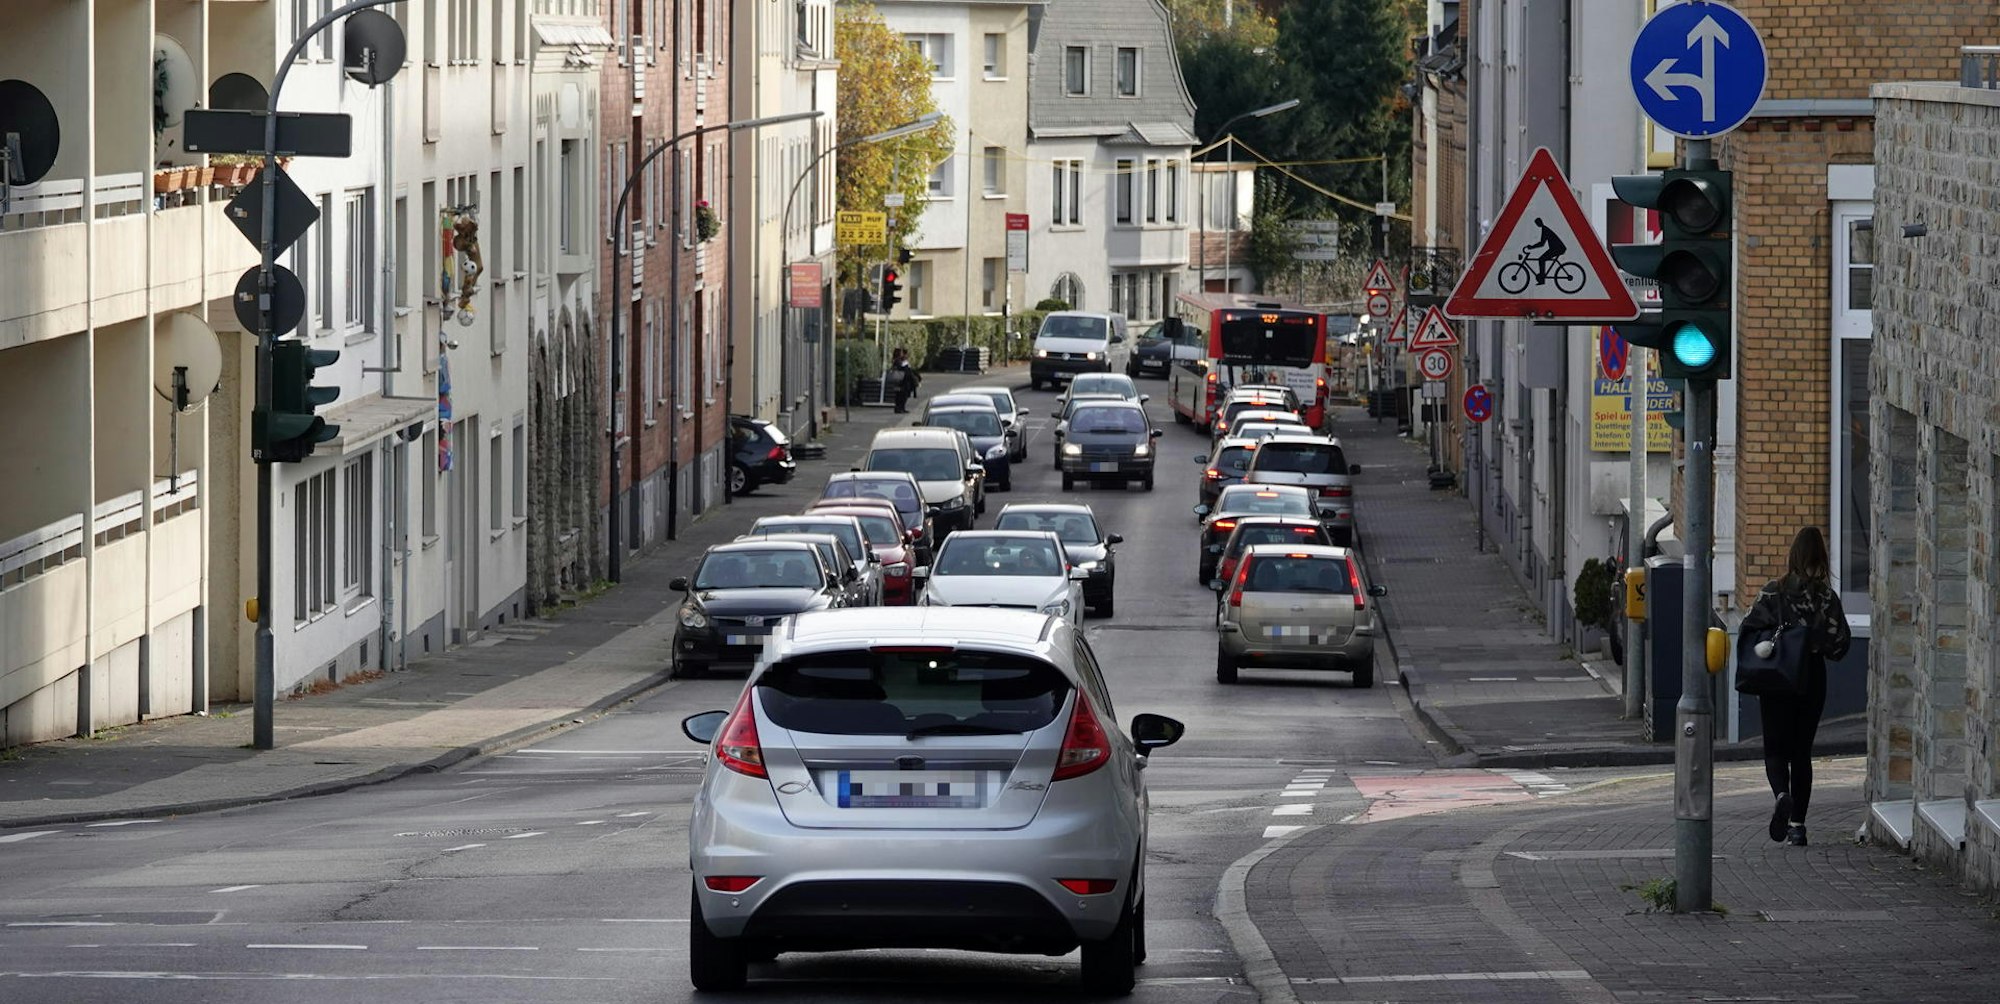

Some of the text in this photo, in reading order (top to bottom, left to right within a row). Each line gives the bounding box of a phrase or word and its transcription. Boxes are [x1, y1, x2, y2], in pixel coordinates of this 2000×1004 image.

[1428, 356, 1446, 371] 30
[1595, 411, 1618, 421] Spiel
[1620, 413, 1632, 421] un
[1595, 423, 1631, 431] Quettinge
